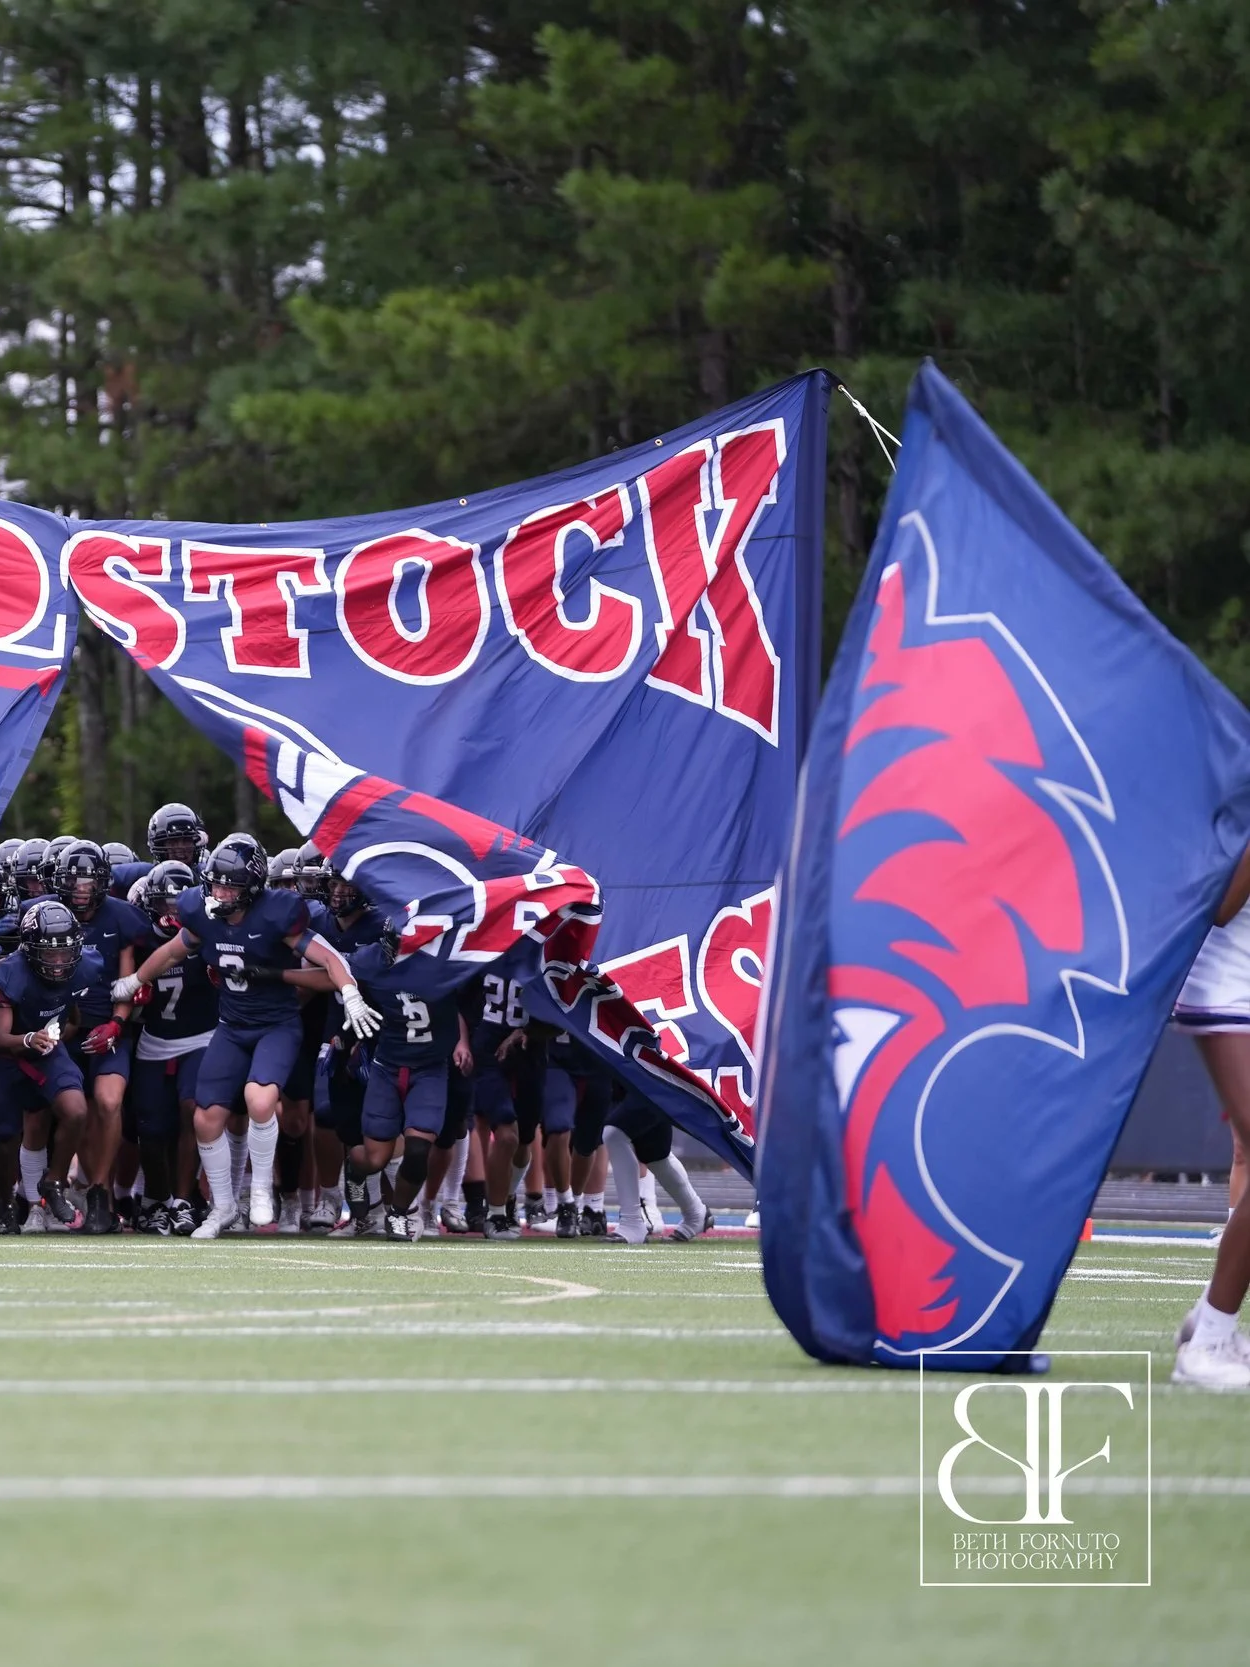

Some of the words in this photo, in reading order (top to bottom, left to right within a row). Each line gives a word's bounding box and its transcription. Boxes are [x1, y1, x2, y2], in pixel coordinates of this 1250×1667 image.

[215, 943, 246, 954] WOODSTOCK
[219, 954, 249, 992] 3
[157, 976, 184, 1021] 7
[402, 1000, 433, 1043] 2
